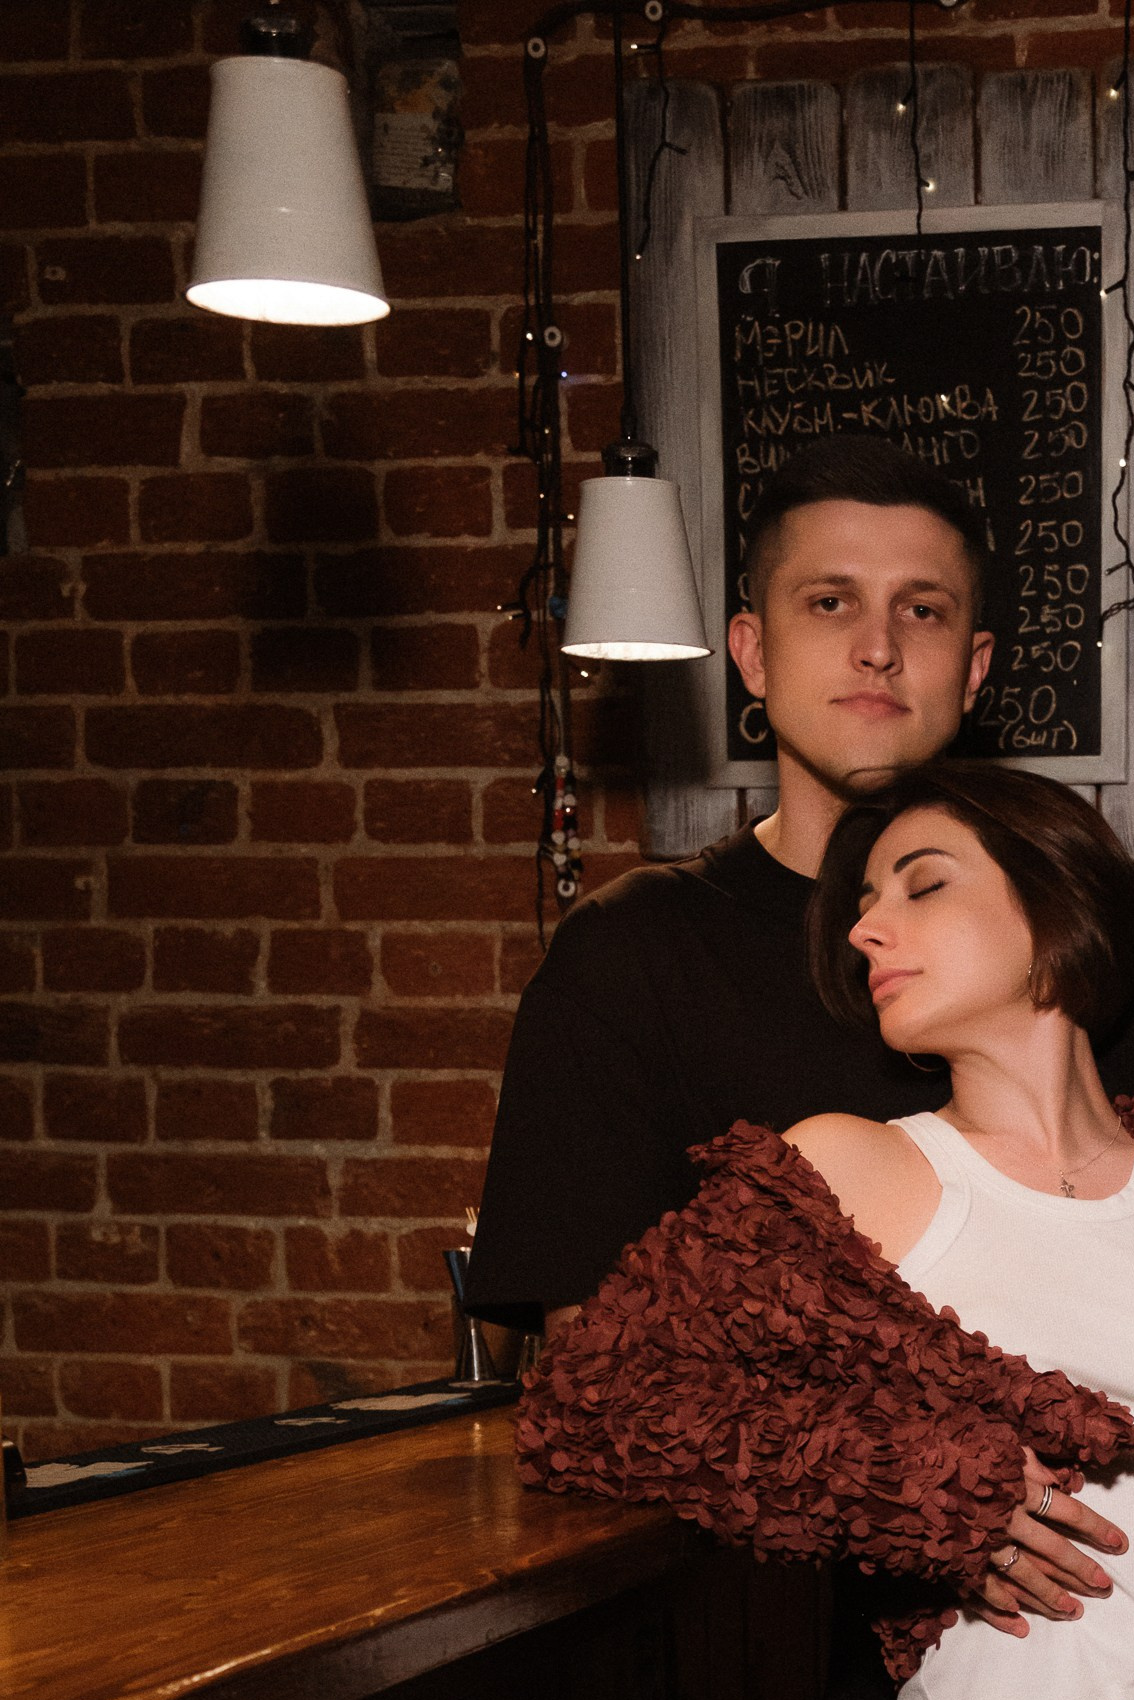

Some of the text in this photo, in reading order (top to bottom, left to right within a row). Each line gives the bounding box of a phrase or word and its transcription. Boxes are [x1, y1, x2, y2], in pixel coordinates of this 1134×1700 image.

[1011, 303, 1085, 346] 250
[1017, 345, 1087, 381] 250
[1021, 380, 1089, 422] 250
[1022, 420, 1089, 460] 250
[1018, 470, 1083, 507] 250
[1014, 519, 1084, 556] 250
[1019, 563, 1090, 600] 250
[1018, 602, 1085, 635] 250
[1010, 640, 1082, 673] 250
[978, 684, 1057, 727] 250
